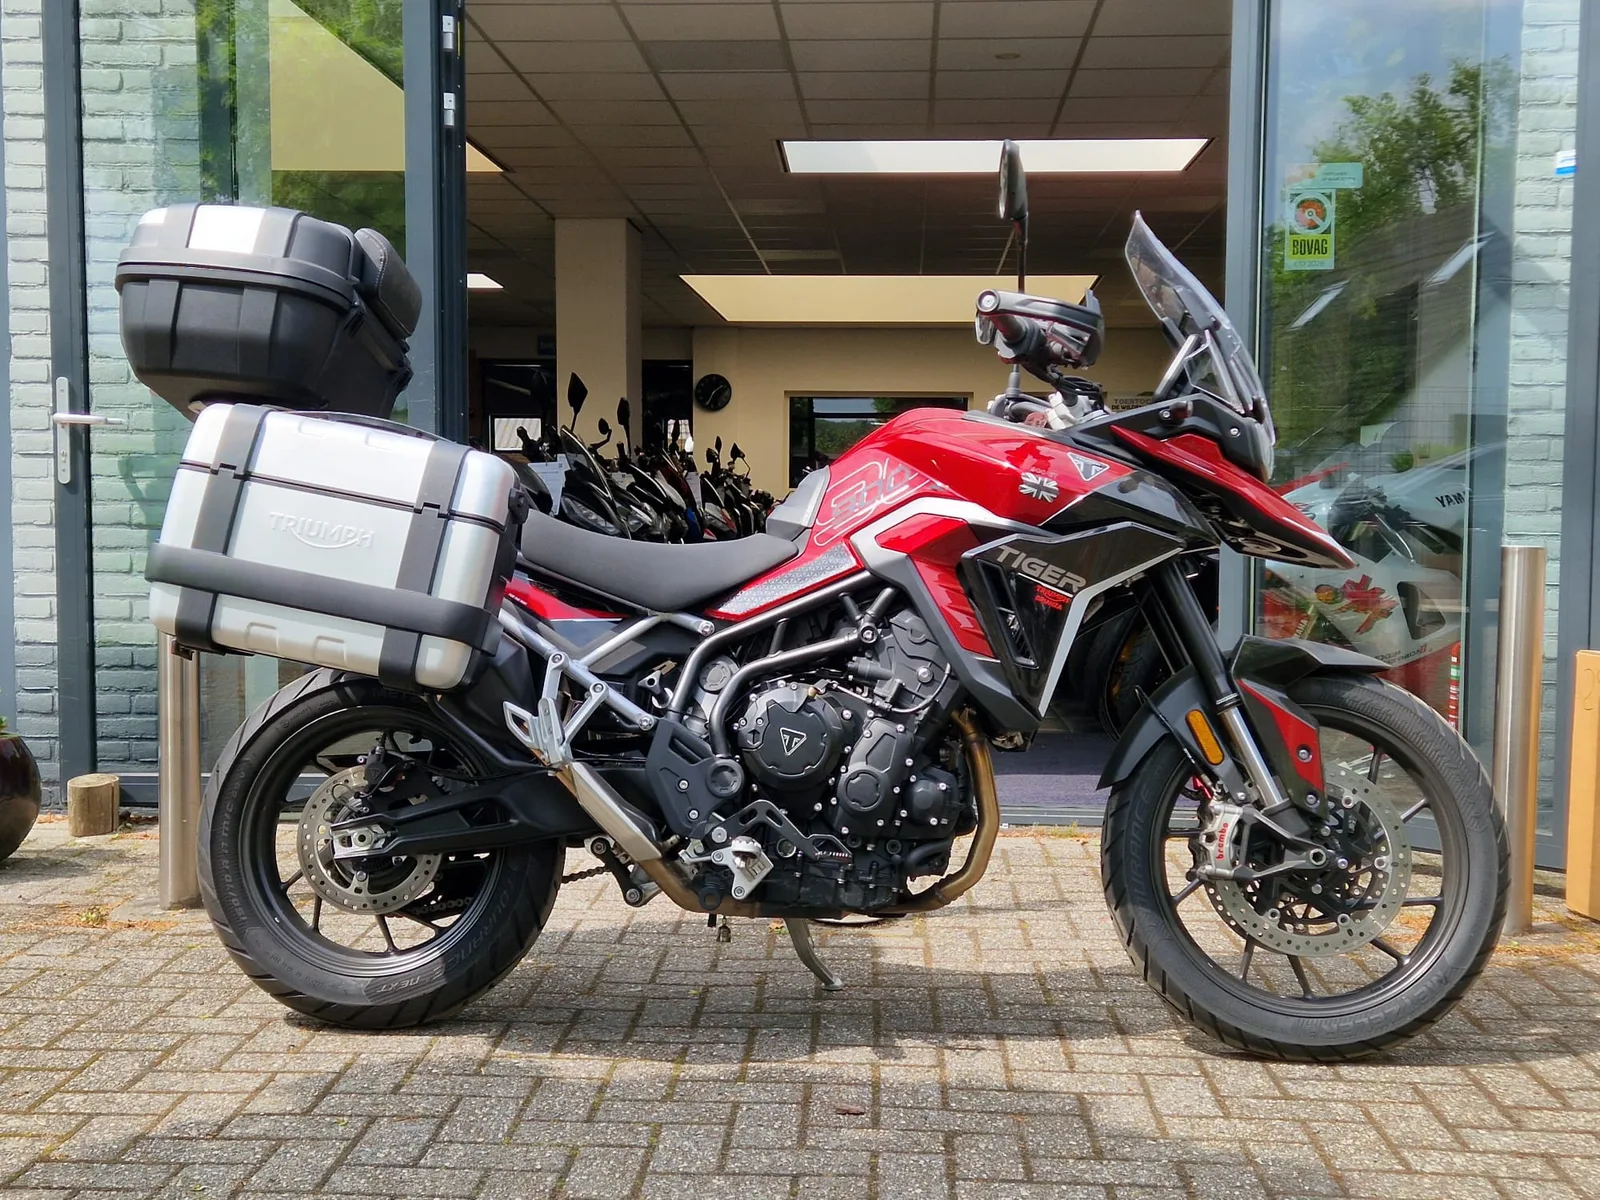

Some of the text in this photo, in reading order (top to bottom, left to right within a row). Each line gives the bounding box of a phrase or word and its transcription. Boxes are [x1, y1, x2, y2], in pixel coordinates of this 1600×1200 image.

[1292, 239, 1328, 255] BOVAG
[1435, 491, 1466, 508] YAM
[269, 511, 375, 549] TRIUMPH
[996, 545, 1087, 593] TIGER
[1216, 822, 1229, 861] brembo
